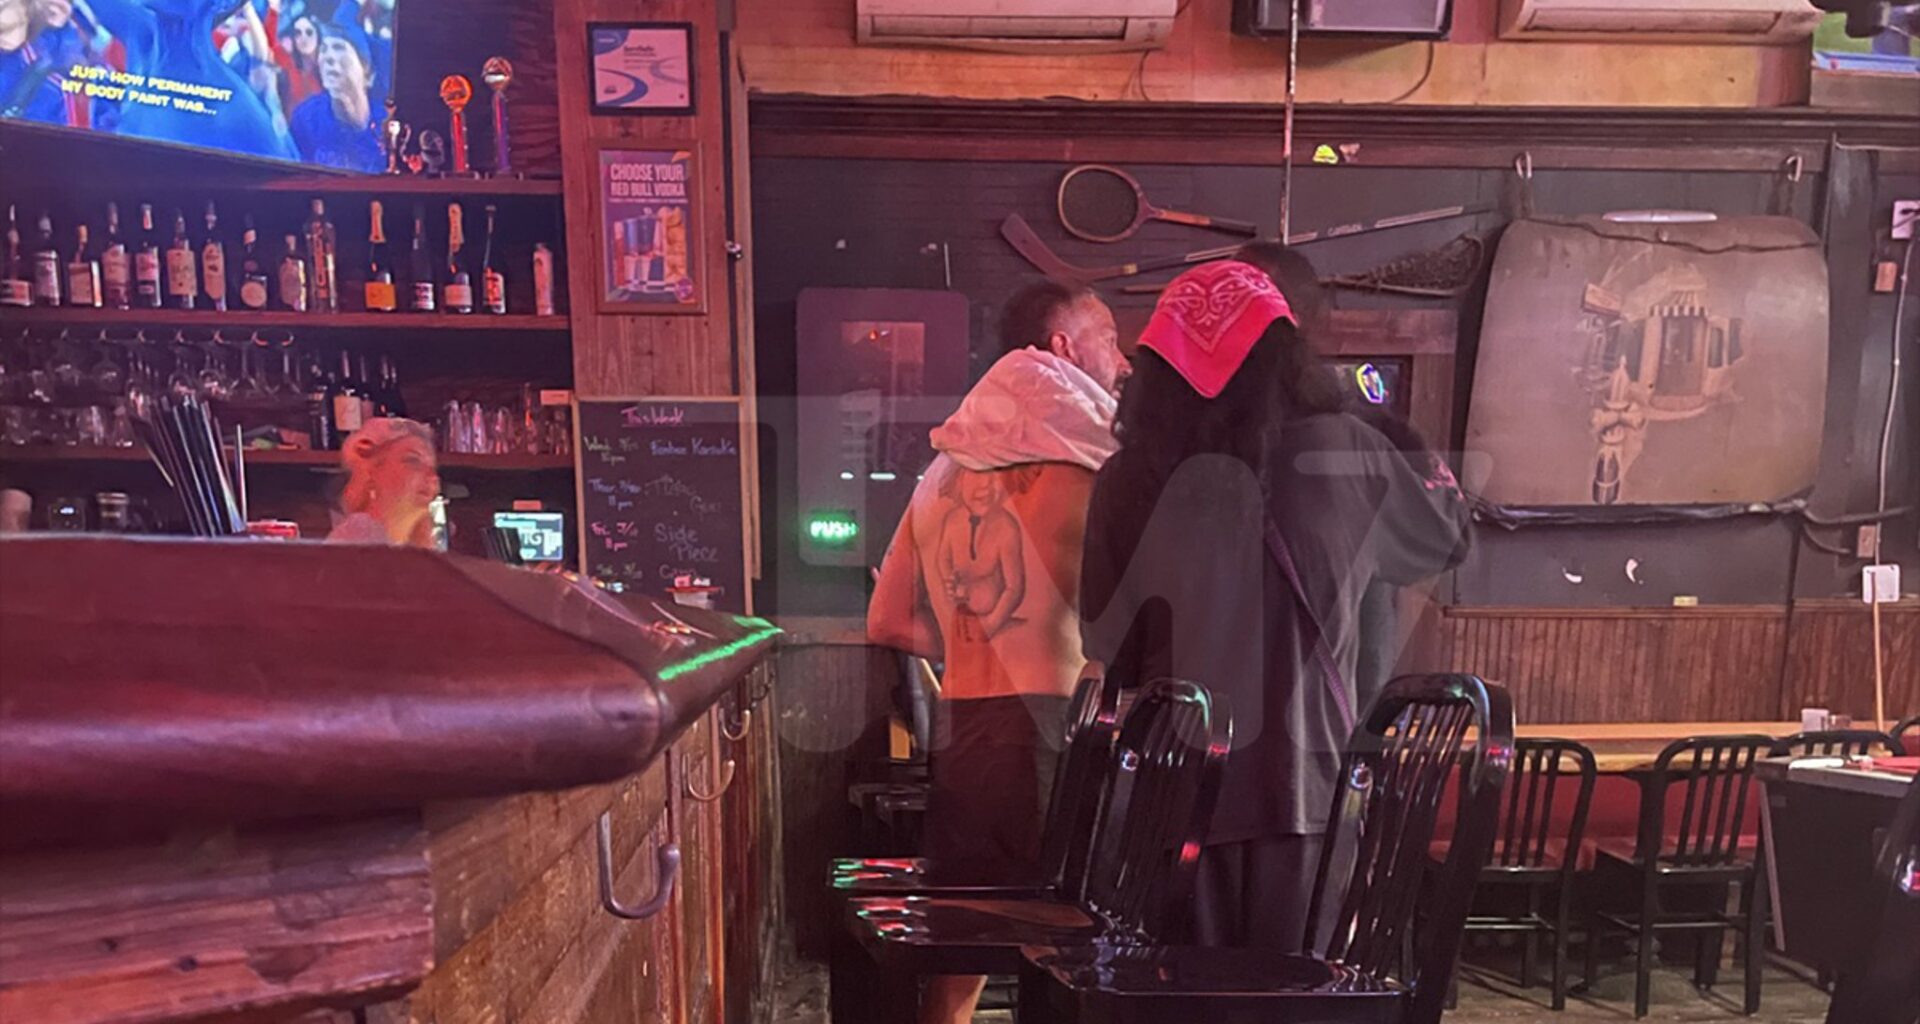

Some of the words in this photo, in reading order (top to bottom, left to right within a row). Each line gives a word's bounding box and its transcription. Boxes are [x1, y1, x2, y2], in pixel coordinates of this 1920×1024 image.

[70, 64, 107, 80] JUST
[109, 70, 145, 87] HOW
[148, 77, 233, 101] PERMANENT
[61, 79, 83, 93] MY
[85, 84, 125, 101] BODY
[128, 90, 170, 107] PAINT
[173, 97, 217, 116] WAS...
[610, 163, 653, 181] CHOOSE
[654, 163, 685, 181] YOUR
[610, 182, 629, 197] RED
[630, 182, 653, 197] BULL
[654, 182, 686, 197] VODKA
[620, 406, 649, 425] This
[650, 405, 685, 425] Week
[654, 523, 698, 544] Side
[810, 520, 858, 538] PUSH
[668, 541, 719, 562] Piece
